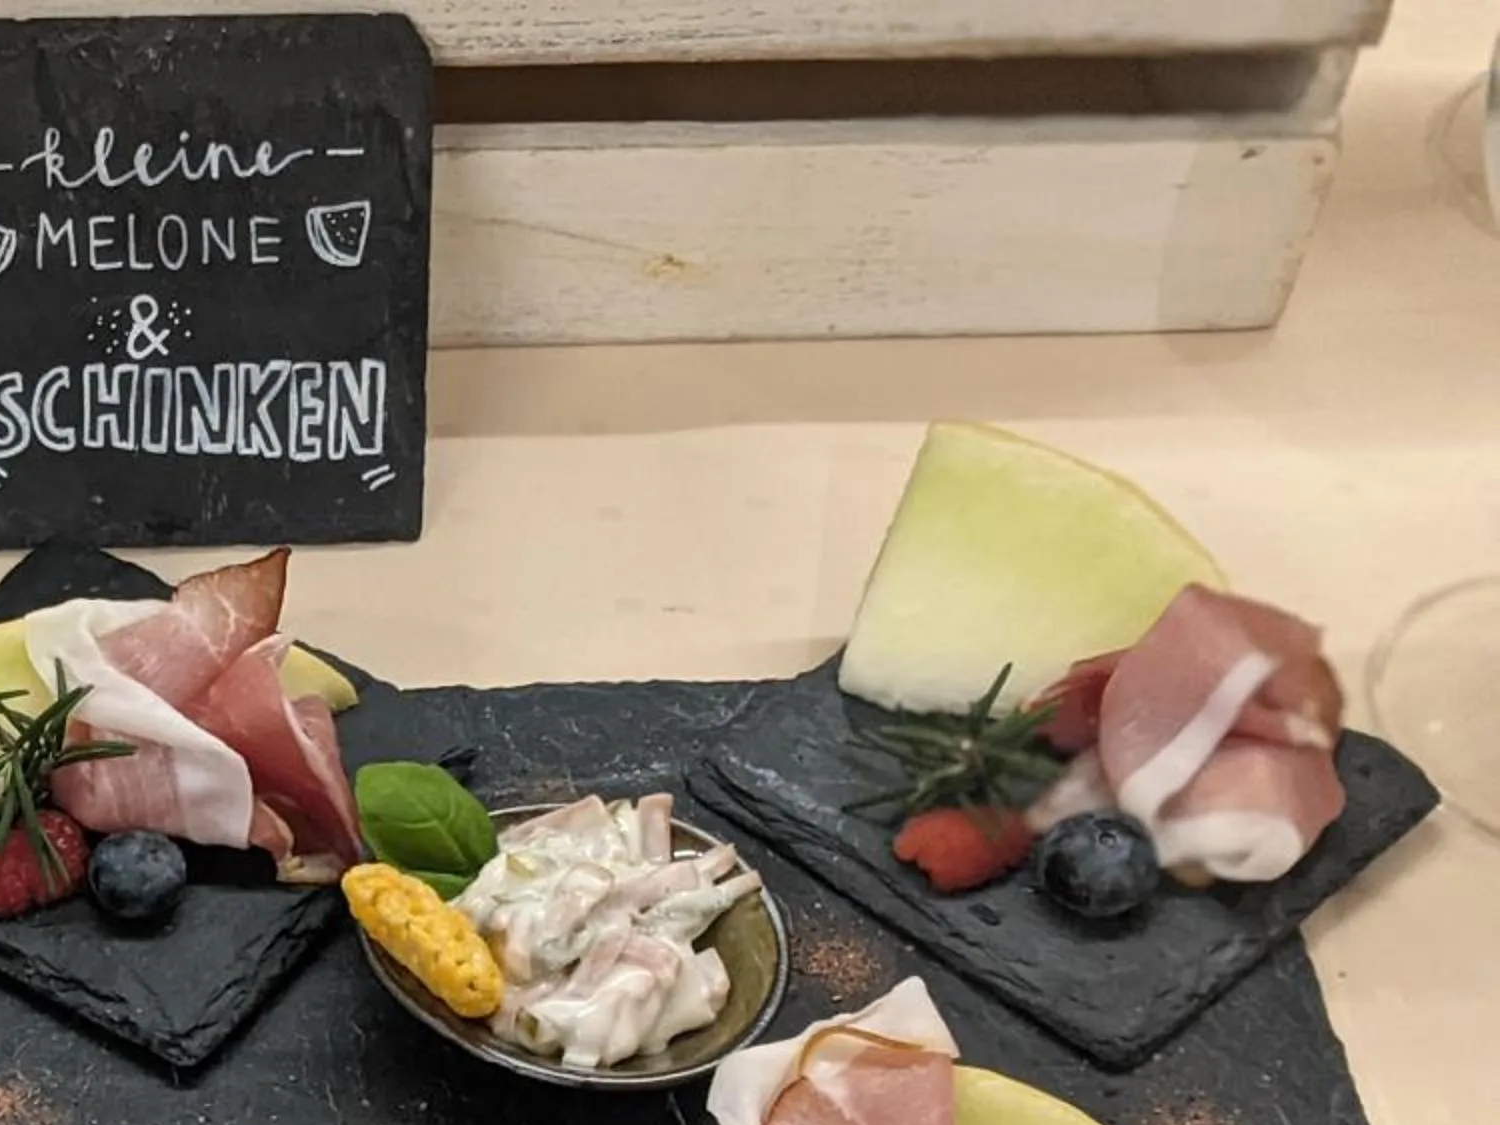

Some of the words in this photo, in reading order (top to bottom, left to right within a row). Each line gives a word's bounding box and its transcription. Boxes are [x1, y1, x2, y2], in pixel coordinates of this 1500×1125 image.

[20, 127, 314, 189] kleine
[36, 212, 282, 271] MELONE
[126, 294, 170, 360] &
